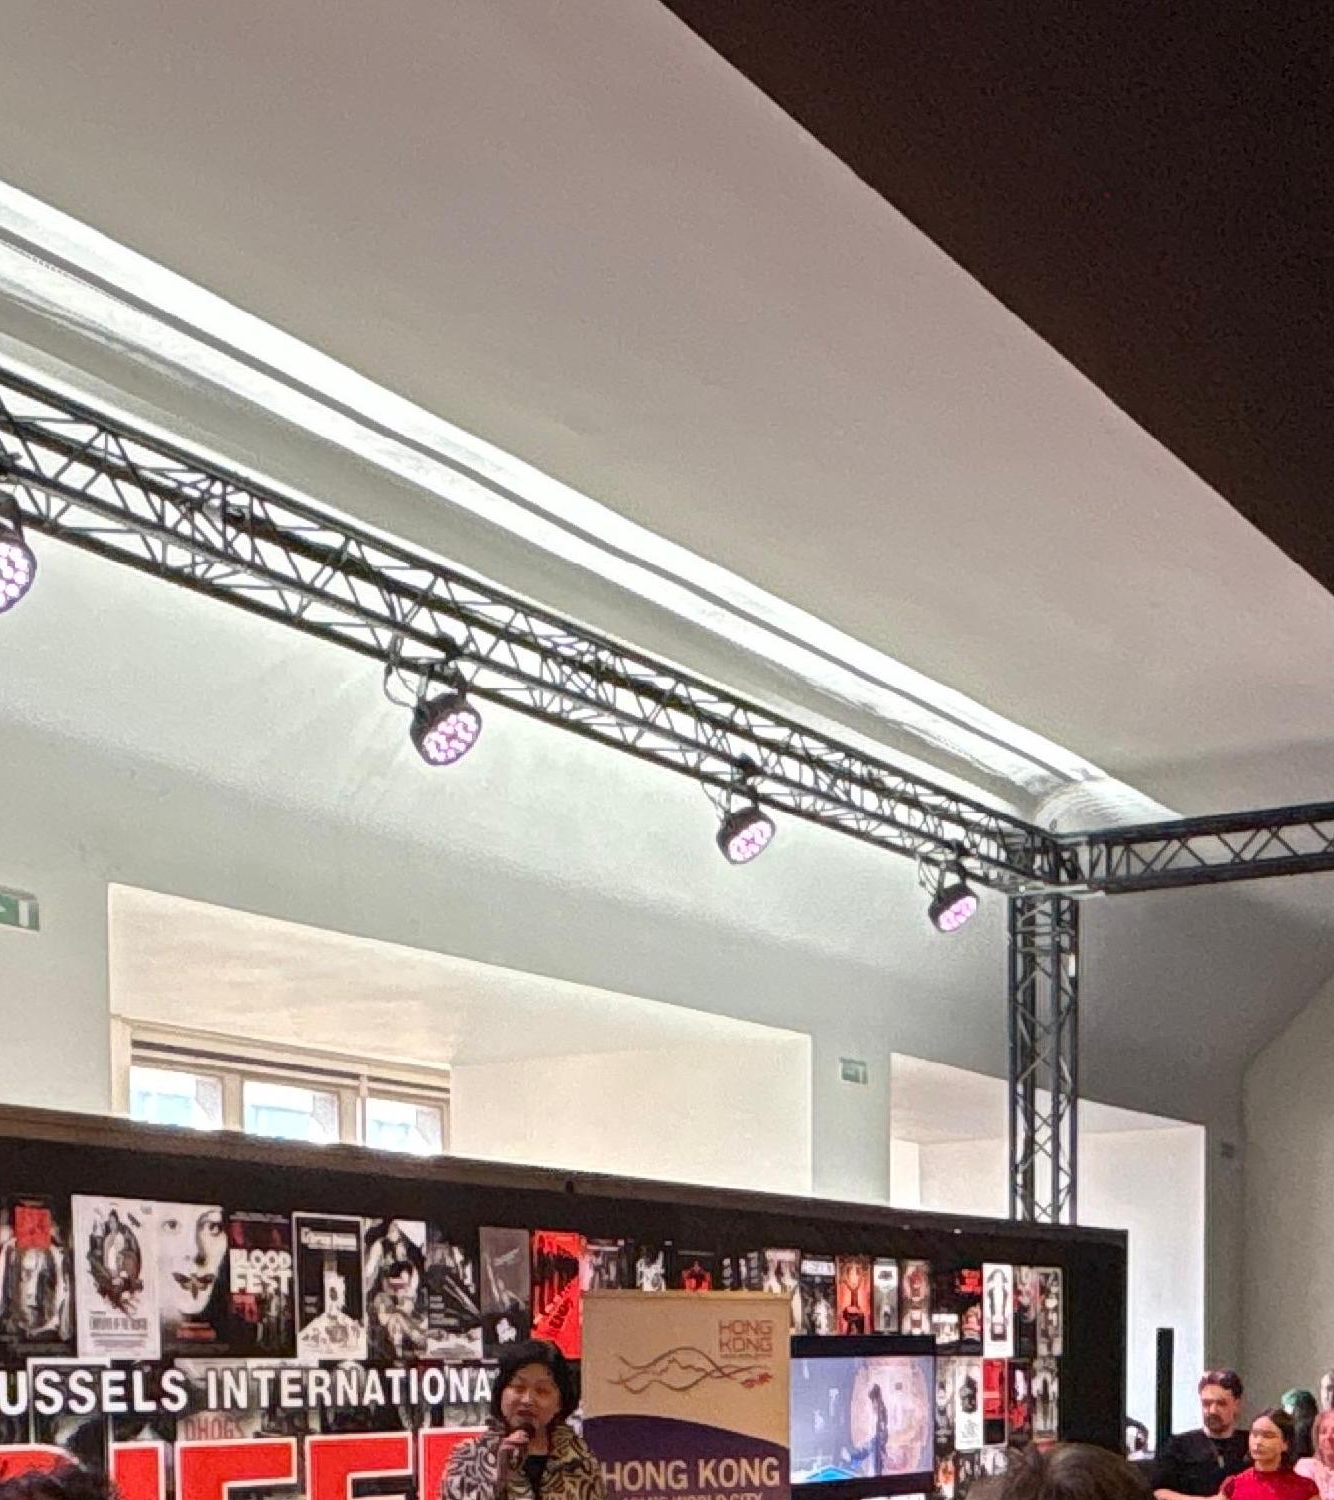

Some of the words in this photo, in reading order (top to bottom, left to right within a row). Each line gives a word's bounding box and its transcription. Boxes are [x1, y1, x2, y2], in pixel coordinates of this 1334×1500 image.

[230, 1268, 292, 1293] FEST
[719, 1320, 772, 1334] HONG
[719, 1337, 772, 1352] KONG
[207, 1366, 492, 1410] INTERNATIONA
[601, 1460, 688, 1492] HONG
[697, 1457, 780, 1489] KONG
